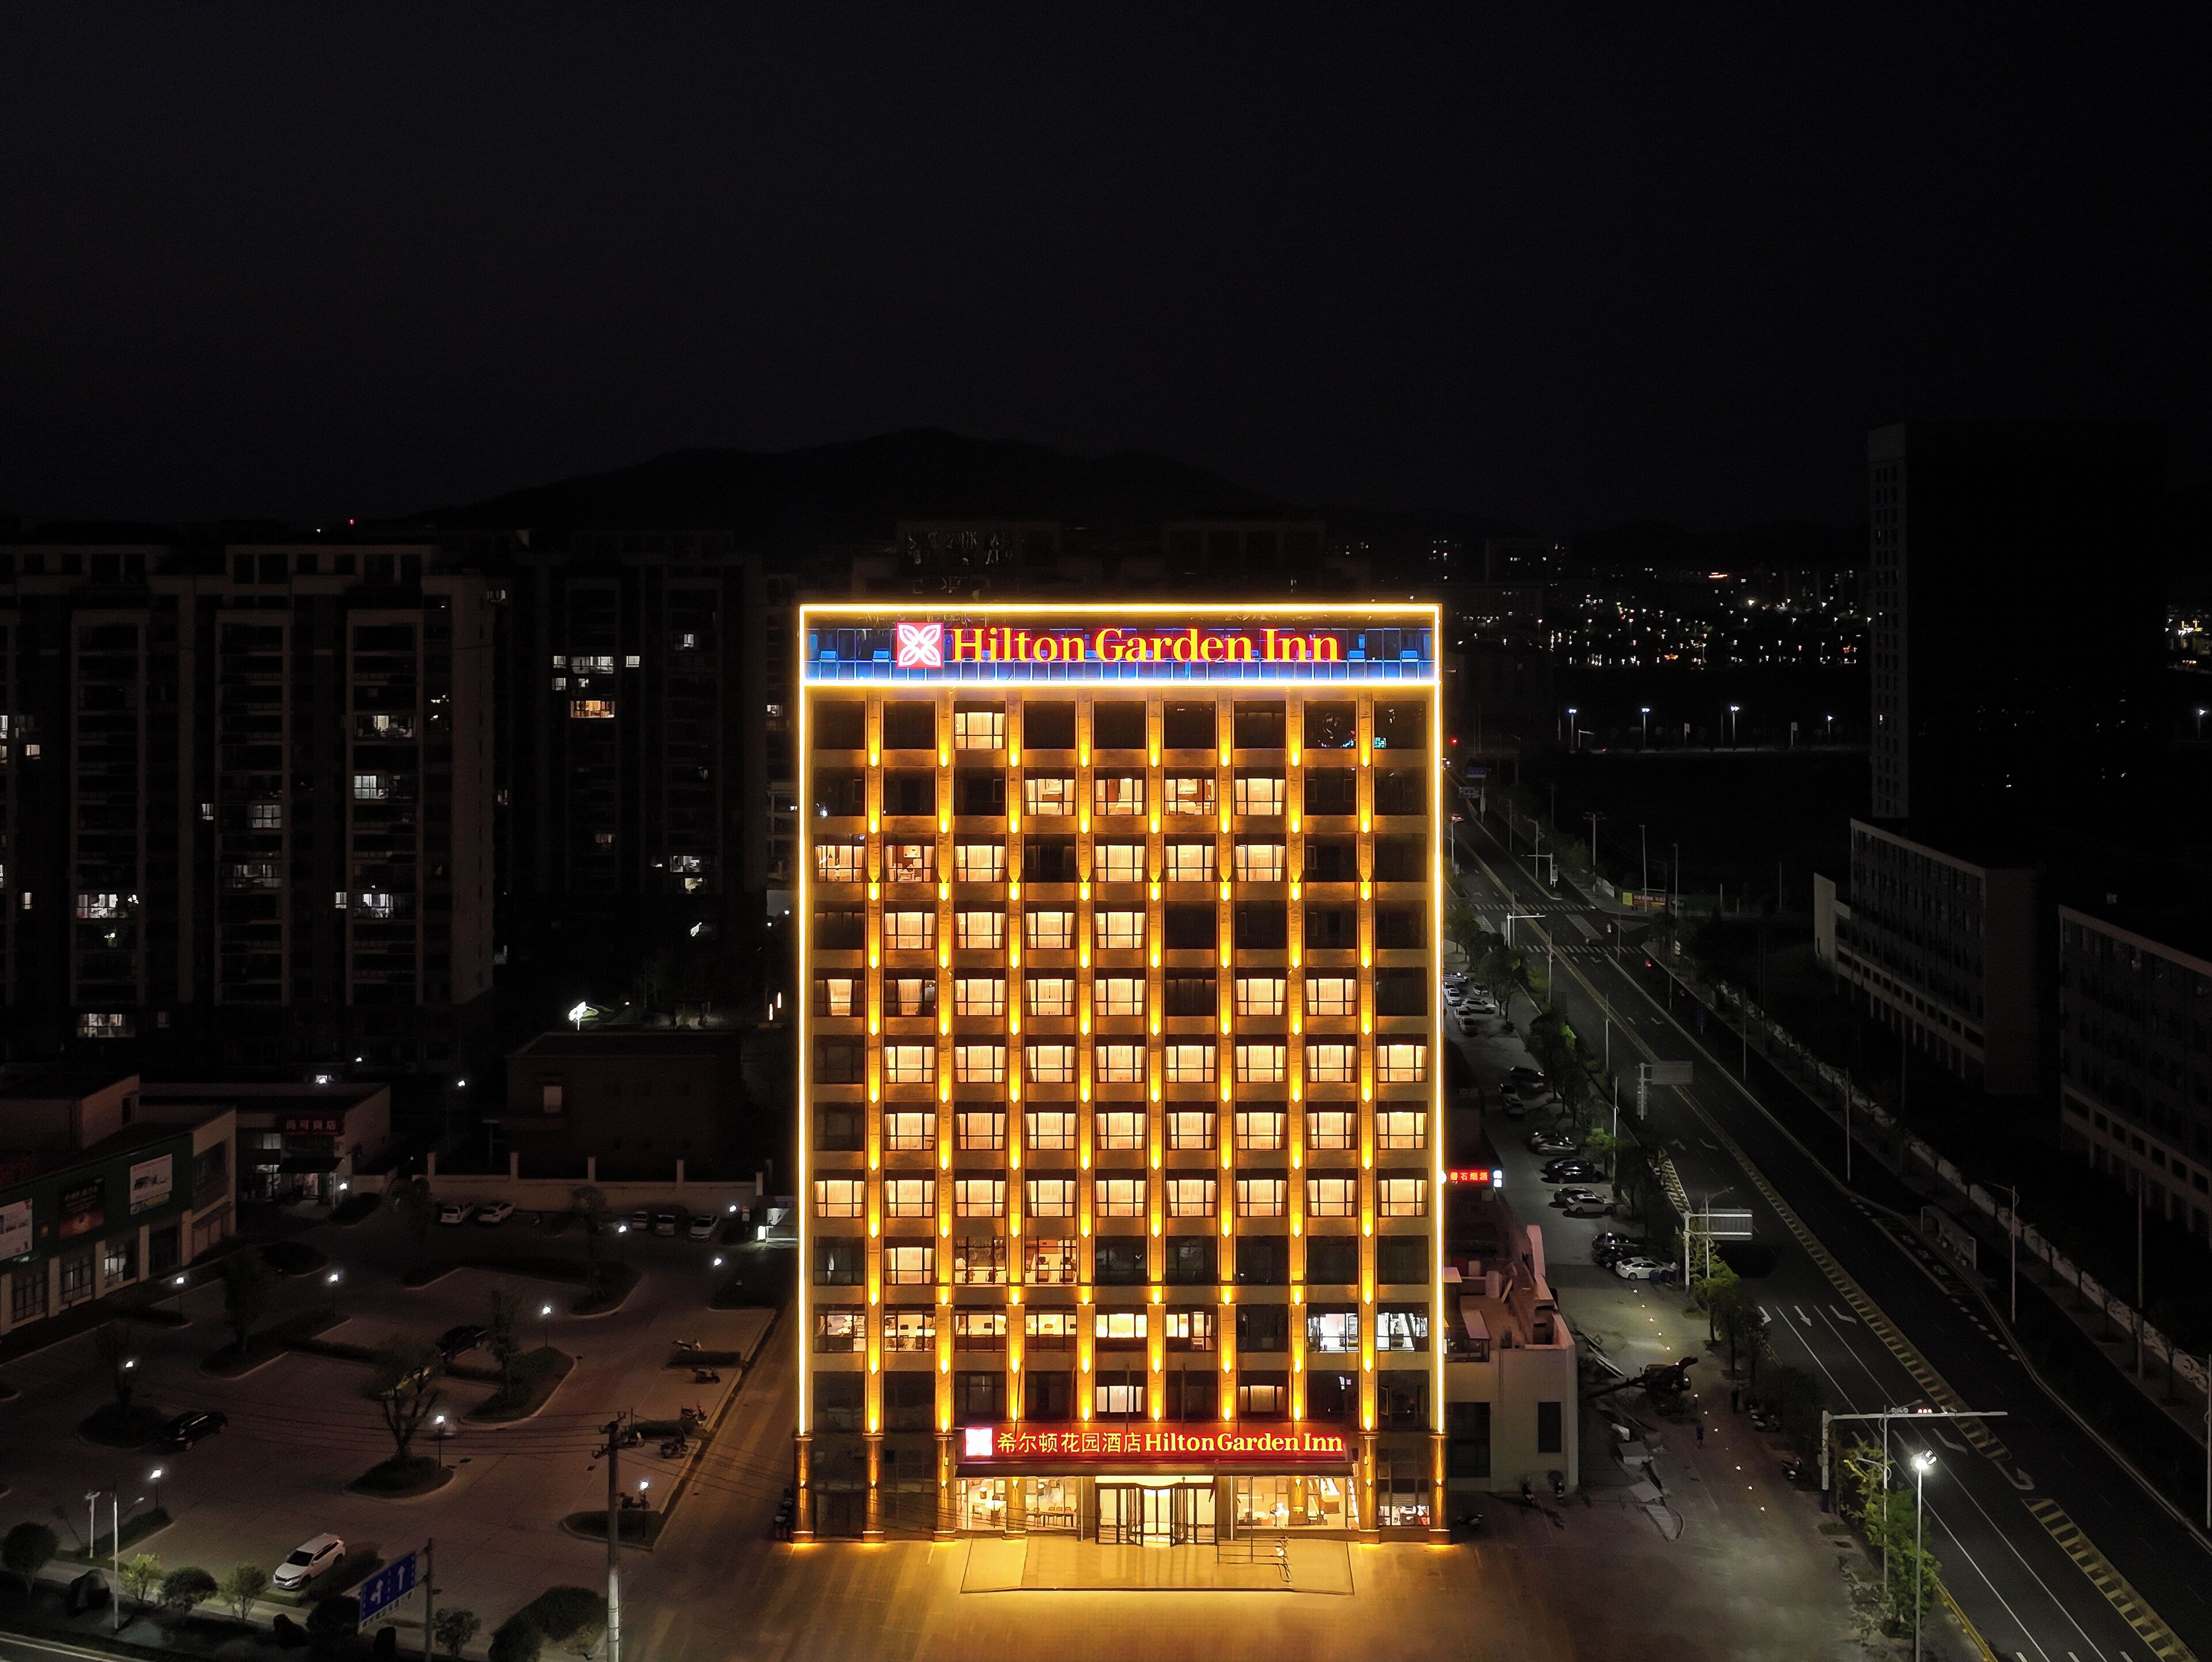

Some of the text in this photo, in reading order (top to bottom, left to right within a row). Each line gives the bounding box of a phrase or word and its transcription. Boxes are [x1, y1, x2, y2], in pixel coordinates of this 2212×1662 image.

[953, 627, 1341, 662] Hilton Garden Inn
[997, 1432, 1343, 1453] 希尔顿花园酒店 Hilton Garden Inn
